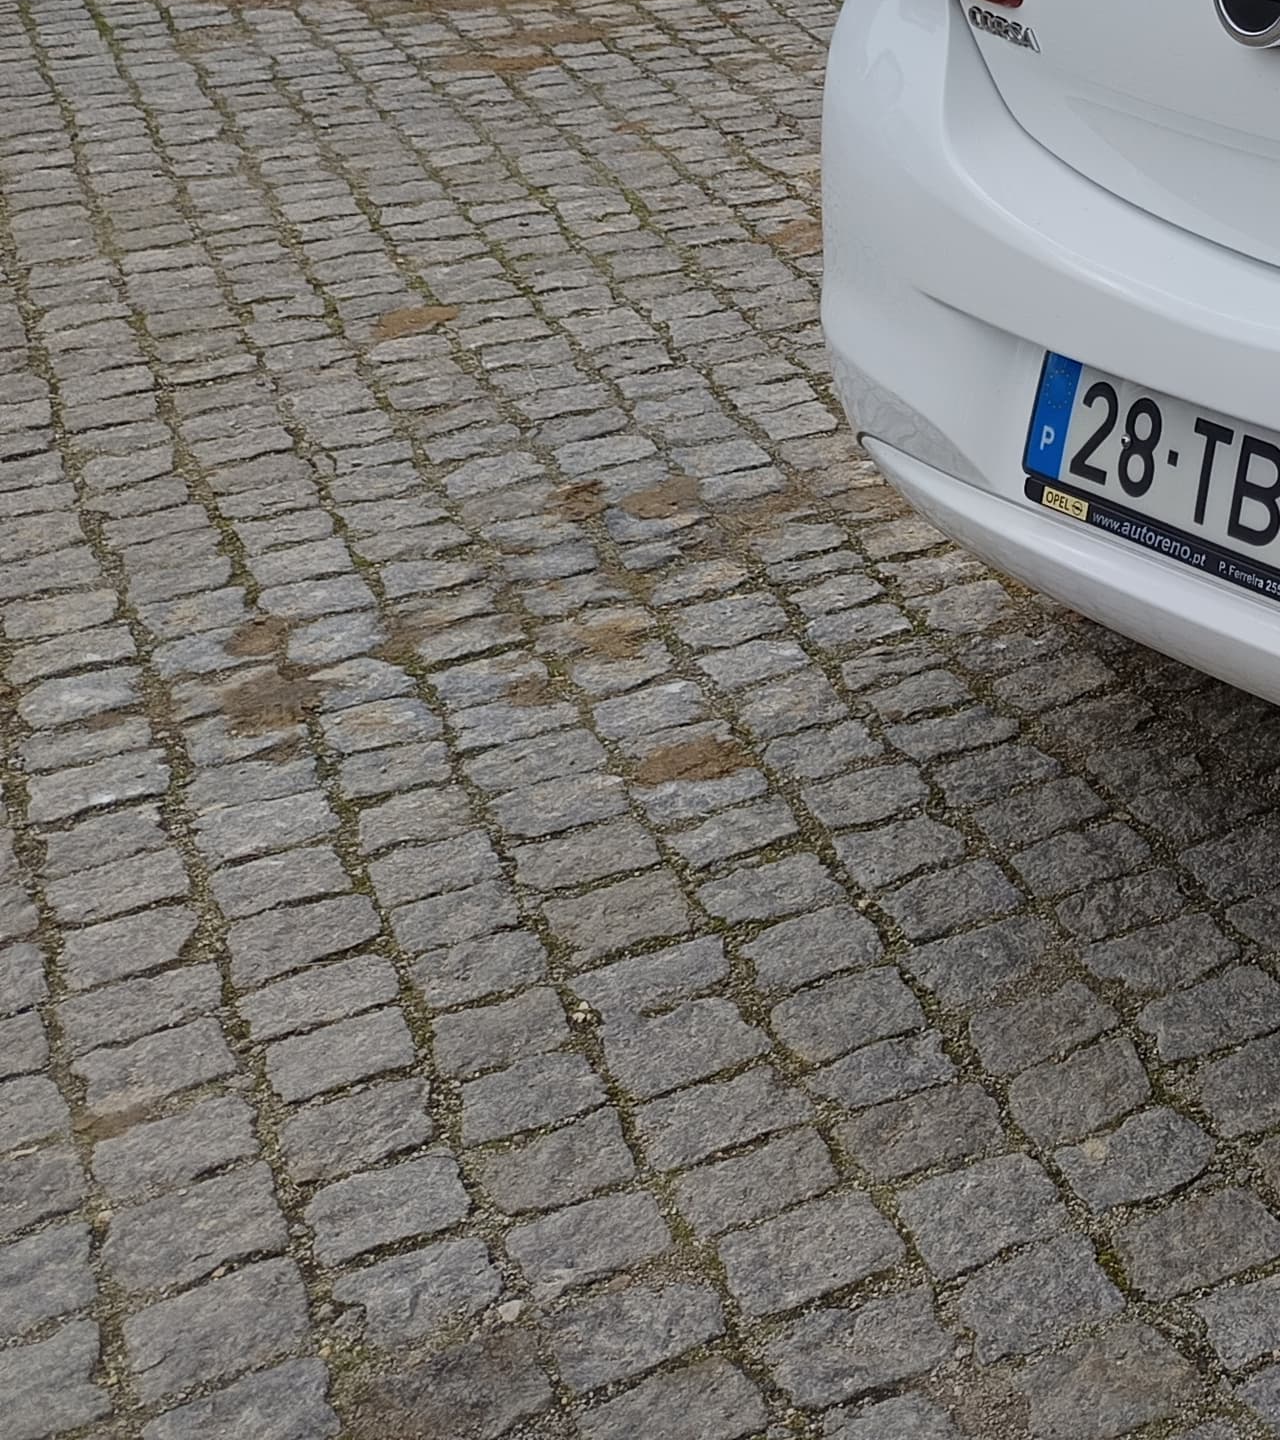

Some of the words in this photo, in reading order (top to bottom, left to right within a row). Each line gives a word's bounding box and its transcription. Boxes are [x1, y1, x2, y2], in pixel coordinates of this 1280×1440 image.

[968, 5, 1041, 53] CORSA
[1040, 424, 1055, 451] P
[1046, 491, 1070, 511] OPEL
[1092, 511, 1206, 569] www.autoreno.pt
[1218, 561, 1228, 575] P.
[1228, 566, 1264, 588] Ferreira
